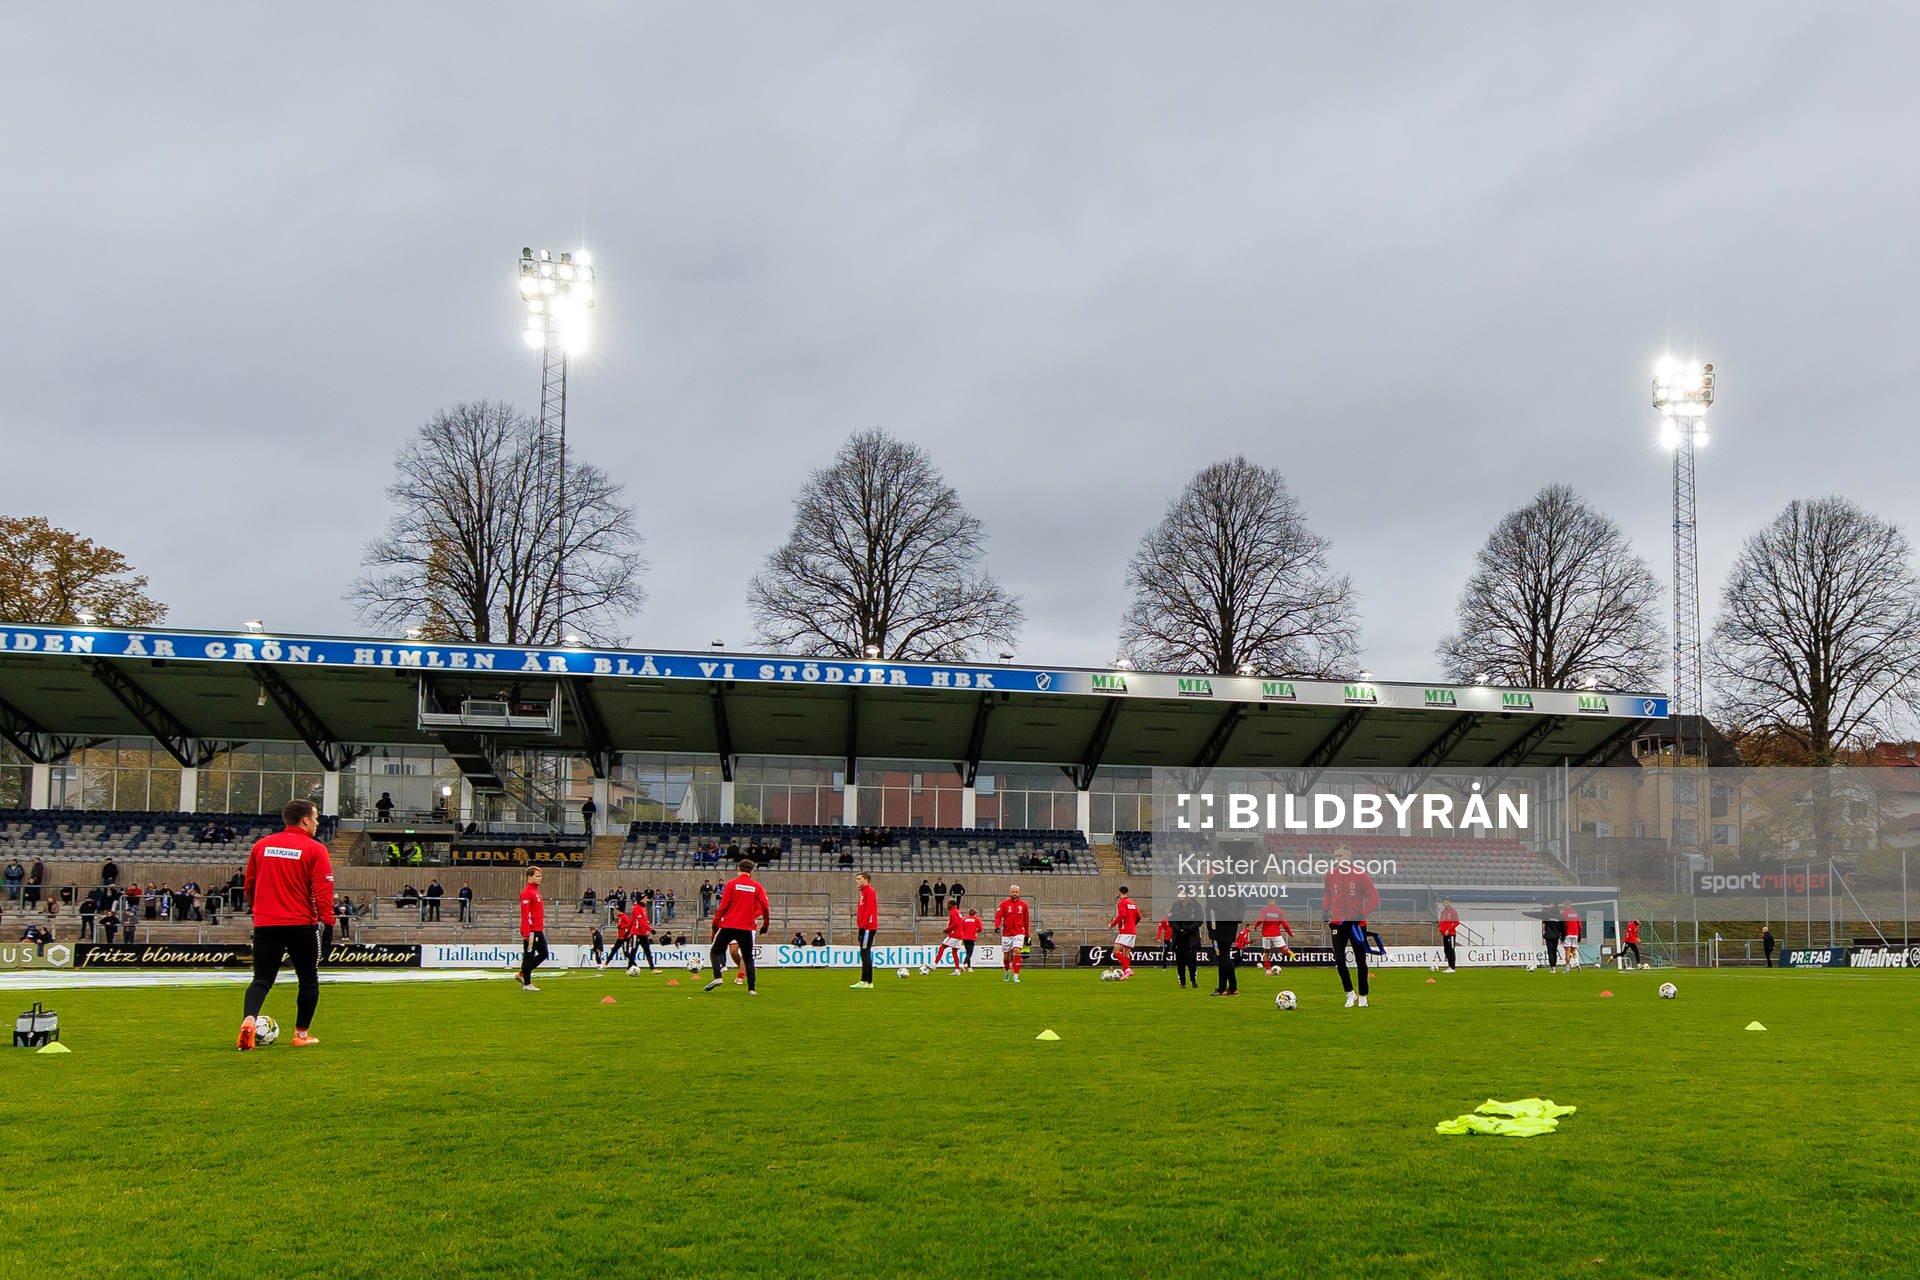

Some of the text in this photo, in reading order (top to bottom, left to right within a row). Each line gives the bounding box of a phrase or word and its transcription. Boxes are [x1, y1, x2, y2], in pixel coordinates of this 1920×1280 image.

[123, 635, 176, 657] ÄR
[204, 640, 326, 663] GRÖN,
[353, 648, 496, 669] HIMLEN
[520, 652, 569, 672] ÄR
[593, 656, 672, 676] BLÅ,
[698, 662, 735, 679] VI
[758, 663, 908, 685] STÖDJER
[931, 671, 994, 689] HBK
[1092, 674, 1127, 690] MTA
[1178, 678, 1212, 693] MTA
[1263, 682, 1295, 697] MTA
[1344, 685, 1377, 700] MTA
[1424, 689, 1457, 704] MTA
[1502, 692, 1534, 708] MTA
[1578, 695, 1609, 711] MTA
[266, 849, 299, 857] YASKAWA
[453, 851, 509, 860] LION
[82, 947, 138, 967] fritz
[141, 947, 234, 963] blommor
[328, 947, 416, 963] blommor
[1468, 949, 1497, 961] Carl
[1790, 951, 1831, 964] PREFAB
[1850, 948, 1909, 968] villalivet
